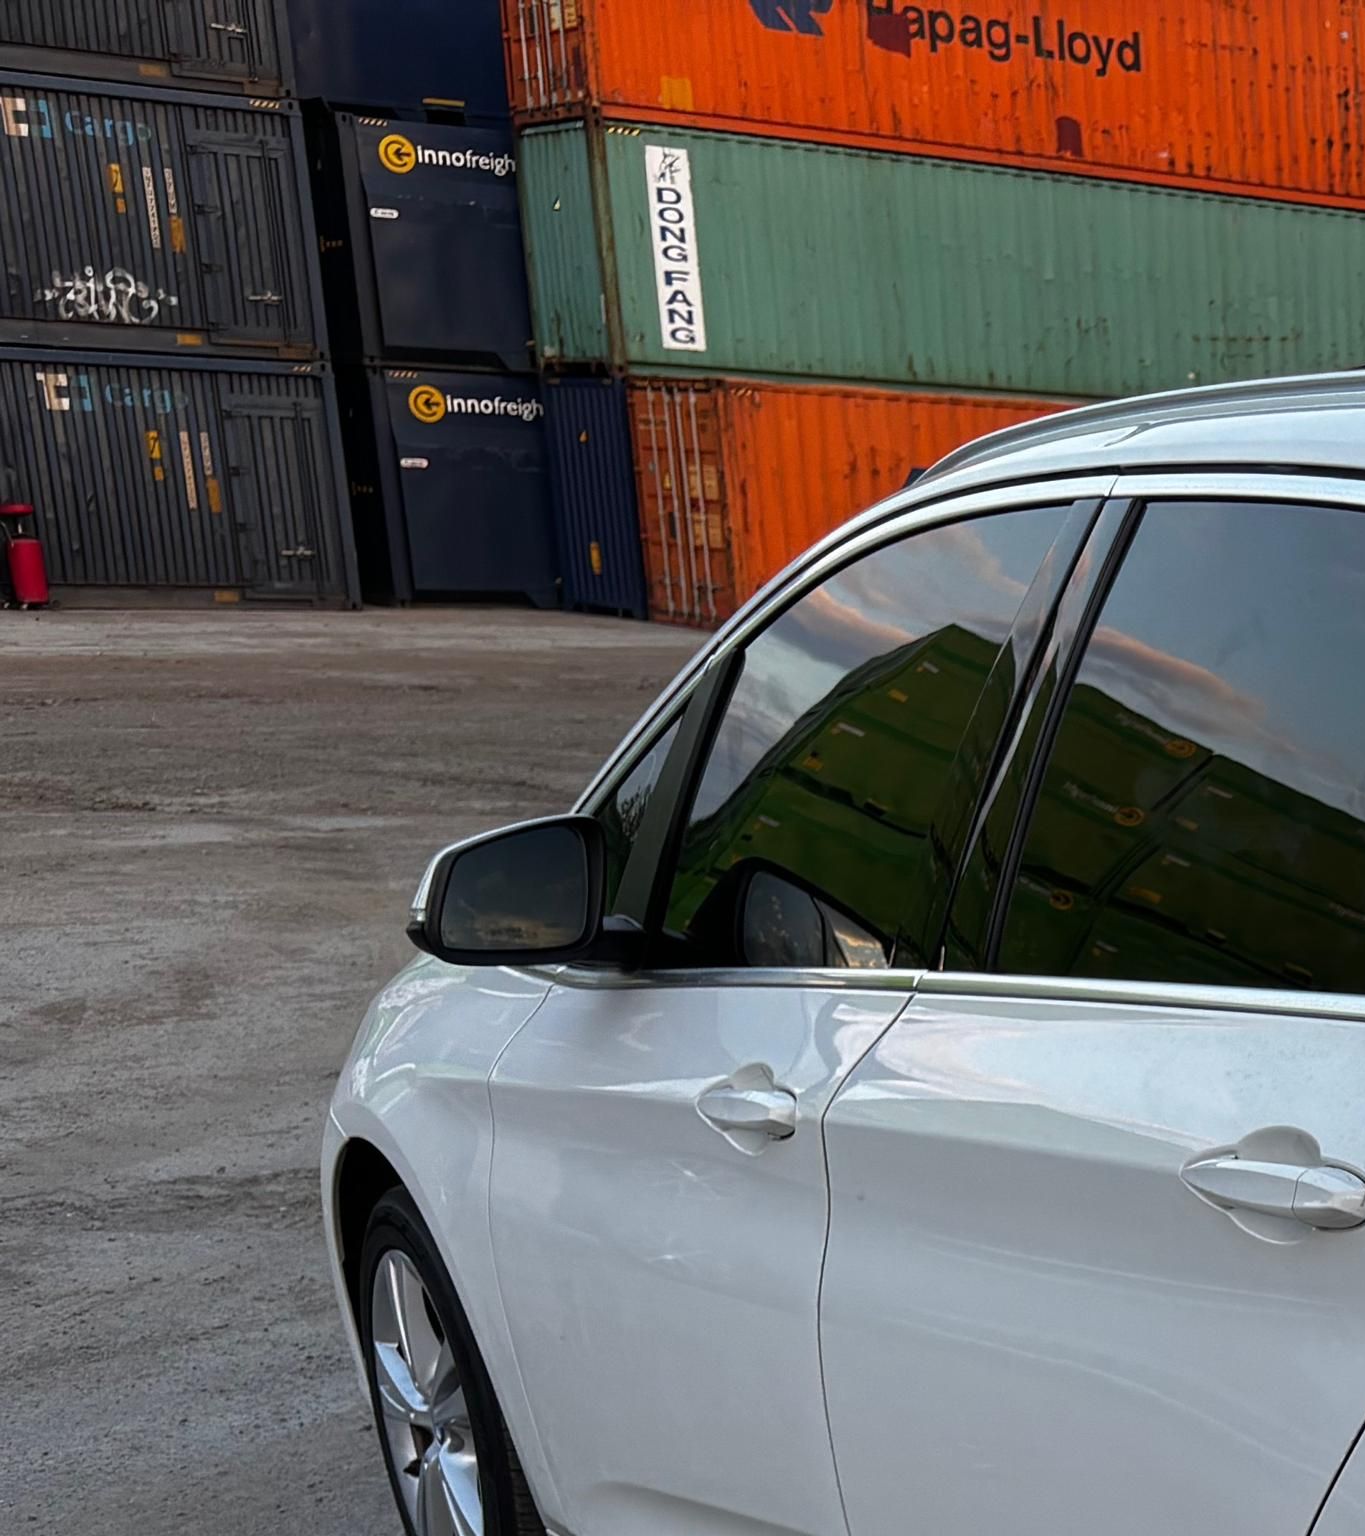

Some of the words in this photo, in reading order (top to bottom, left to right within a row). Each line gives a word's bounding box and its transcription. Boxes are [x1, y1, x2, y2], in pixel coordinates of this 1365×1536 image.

[416, 144, 517, 177] Innofreigh
[656, 186, 689, 263] DONG
[663, 270, 696, 344] FANG
[445, 393, 545, 422] Innofreigh
